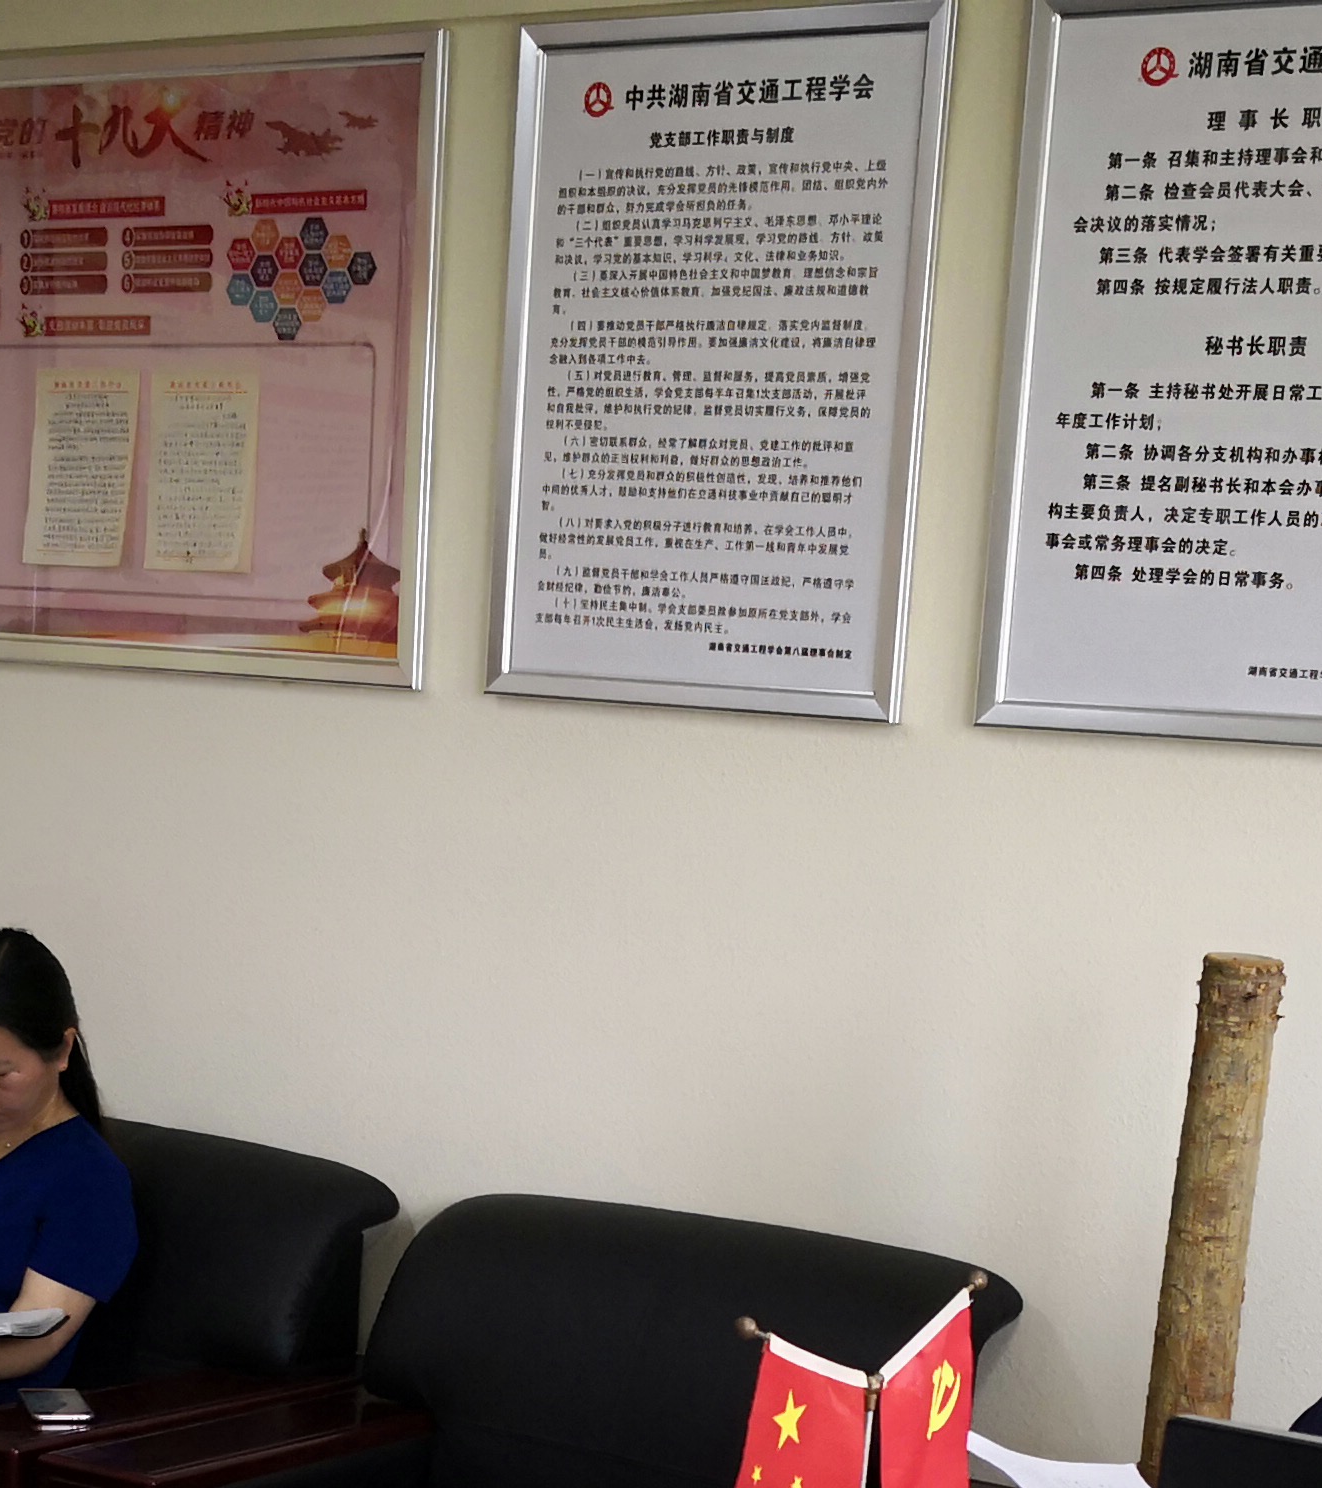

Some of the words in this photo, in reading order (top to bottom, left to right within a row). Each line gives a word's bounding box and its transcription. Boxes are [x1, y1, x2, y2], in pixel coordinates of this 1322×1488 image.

[625, 73, 875, 110] 中共湖南省交通工程学会
[55, 105, 212, 167] 十九大
[194, 110, 256, 140] 精神
[649, 127, 794, 148] 党支部工作职责与制度
[1108, 151, 1157, 170] 第一条
[1104, 183, 1155, 201] 第二条
[1073, 215, 1217, 233] 会决议的落实情况；
[1099, 247, 1148, 265] 第三条
[1095, 278, 1146, 296] 第四条
[1154, 277, 1320, 296] 按规定履行法人职责。
[1205, 335, 1307, 357] 秘书长职责
[1090, 382, 1140, 400] 第一条
[1056, 412, 1162, 431] 年度工作计划；
[1085, 443, 1134, 461] 第二条
[1082, 473, 1132, 492] 第三条
[1045, 532, 1236, 557] 事会或常务理事会的决定。
[1074, 563, 1123, 583] 第四条
[1131, 565, 1293, 591] 处理学会的日常事务。
